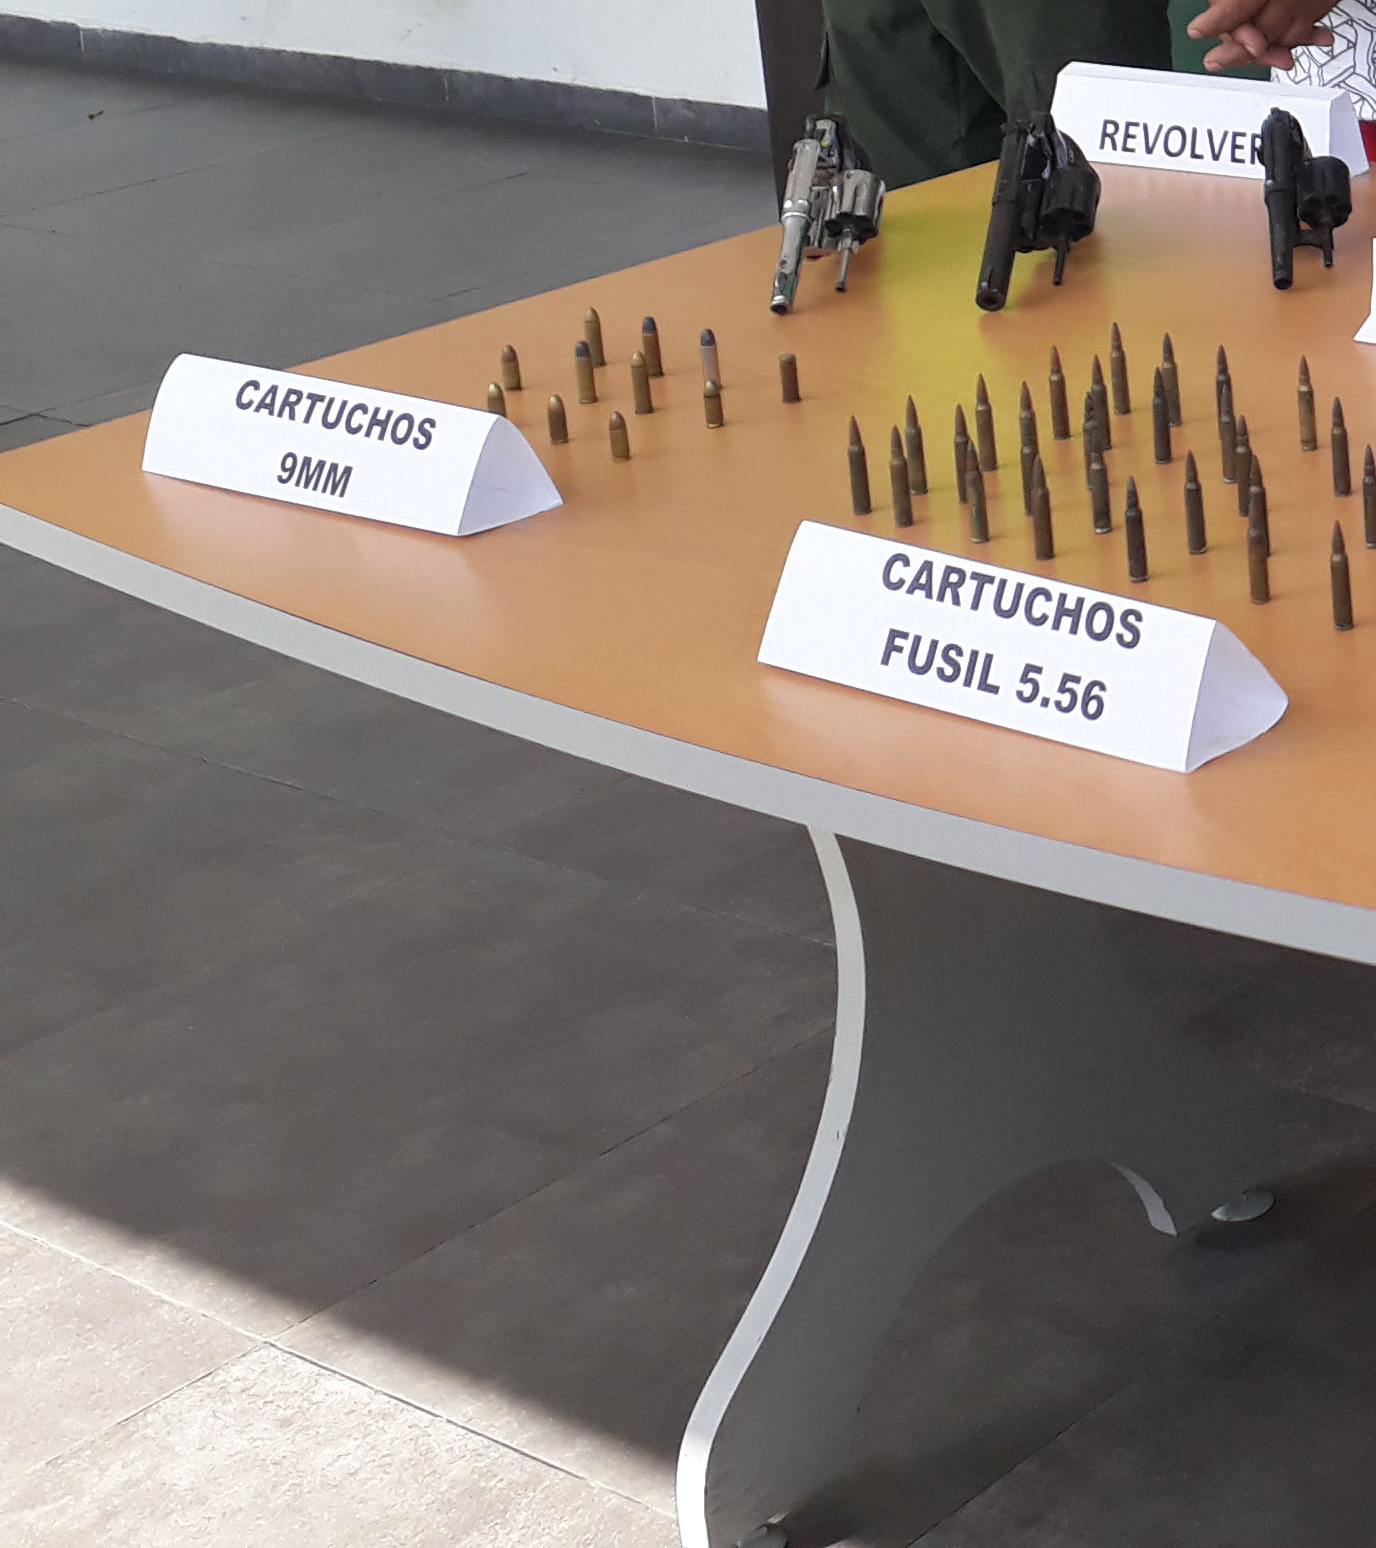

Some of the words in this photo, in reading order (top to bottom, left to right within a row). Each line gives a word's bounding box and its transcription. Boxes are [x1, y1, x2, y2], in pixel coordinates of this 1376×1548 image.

[234, 378, 437, 451] CARTUCHOS
[276, 451, 354, 499] 9MM
[882, 552, 1144, 650] CARTUCHOS
[880, 628, 1000, 696] FUSIL
[1015, 663, 1106, 721] 5.56
